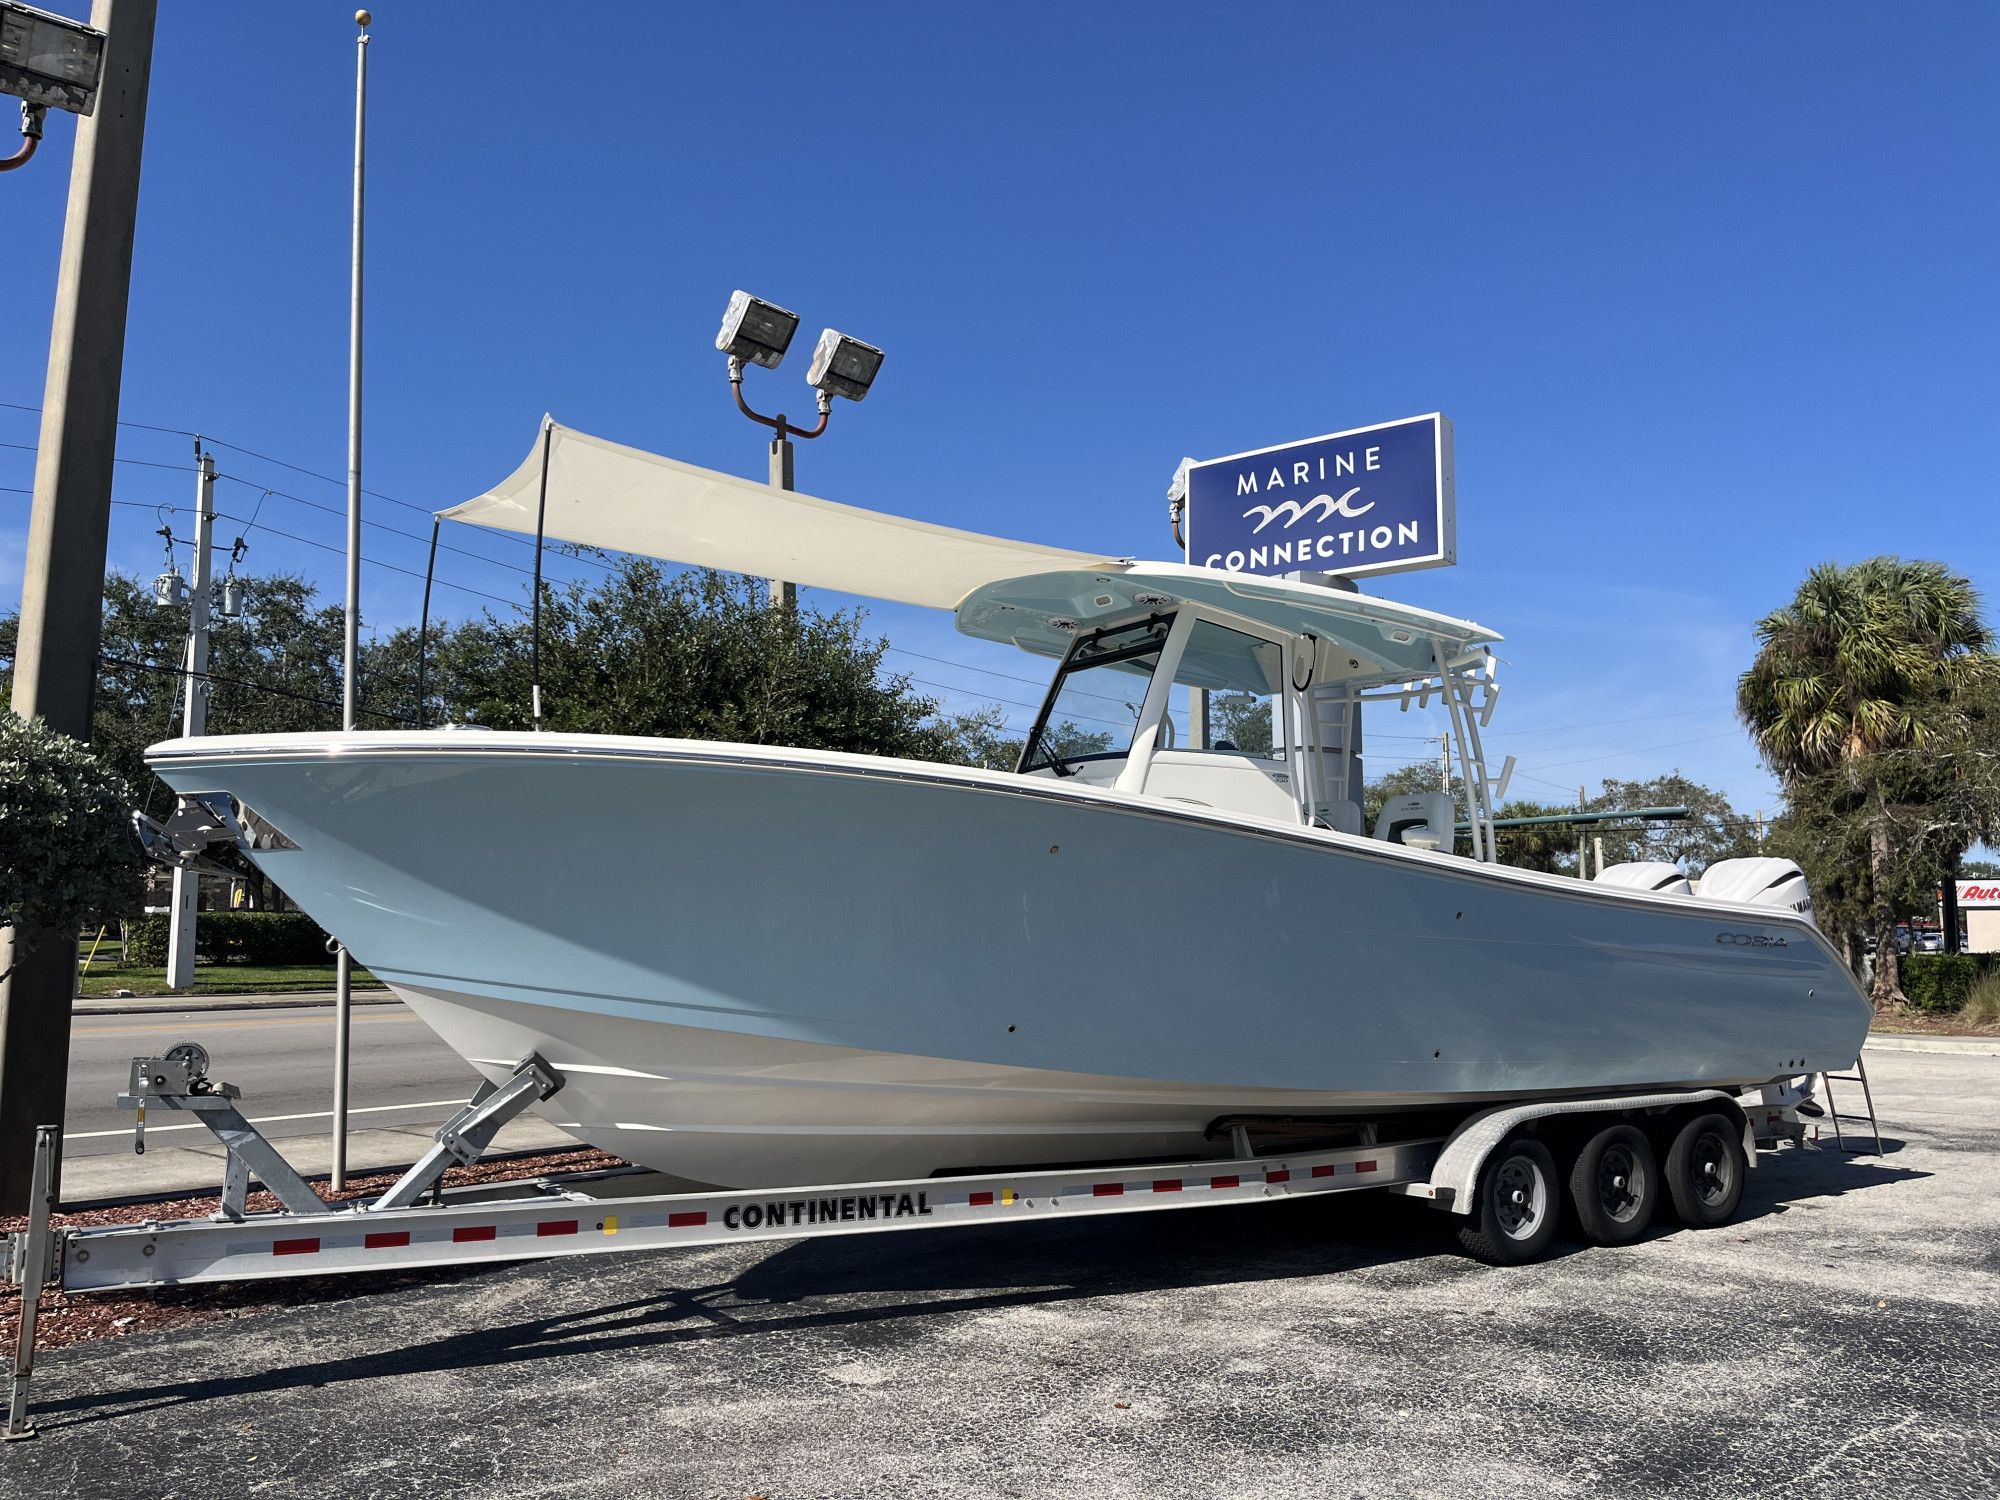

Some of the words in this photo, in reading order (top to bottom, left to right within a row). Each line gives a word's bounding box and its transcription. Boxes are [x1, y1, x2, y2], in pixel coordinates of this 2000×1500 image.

[1237, 446, 1380, 496] MARINE
[1205, 520, 1418, 572] CONNECTION
[1715, 932, 1788, 948] COBIA
[723, 1191, 933, 1230] CONTINENTAL
